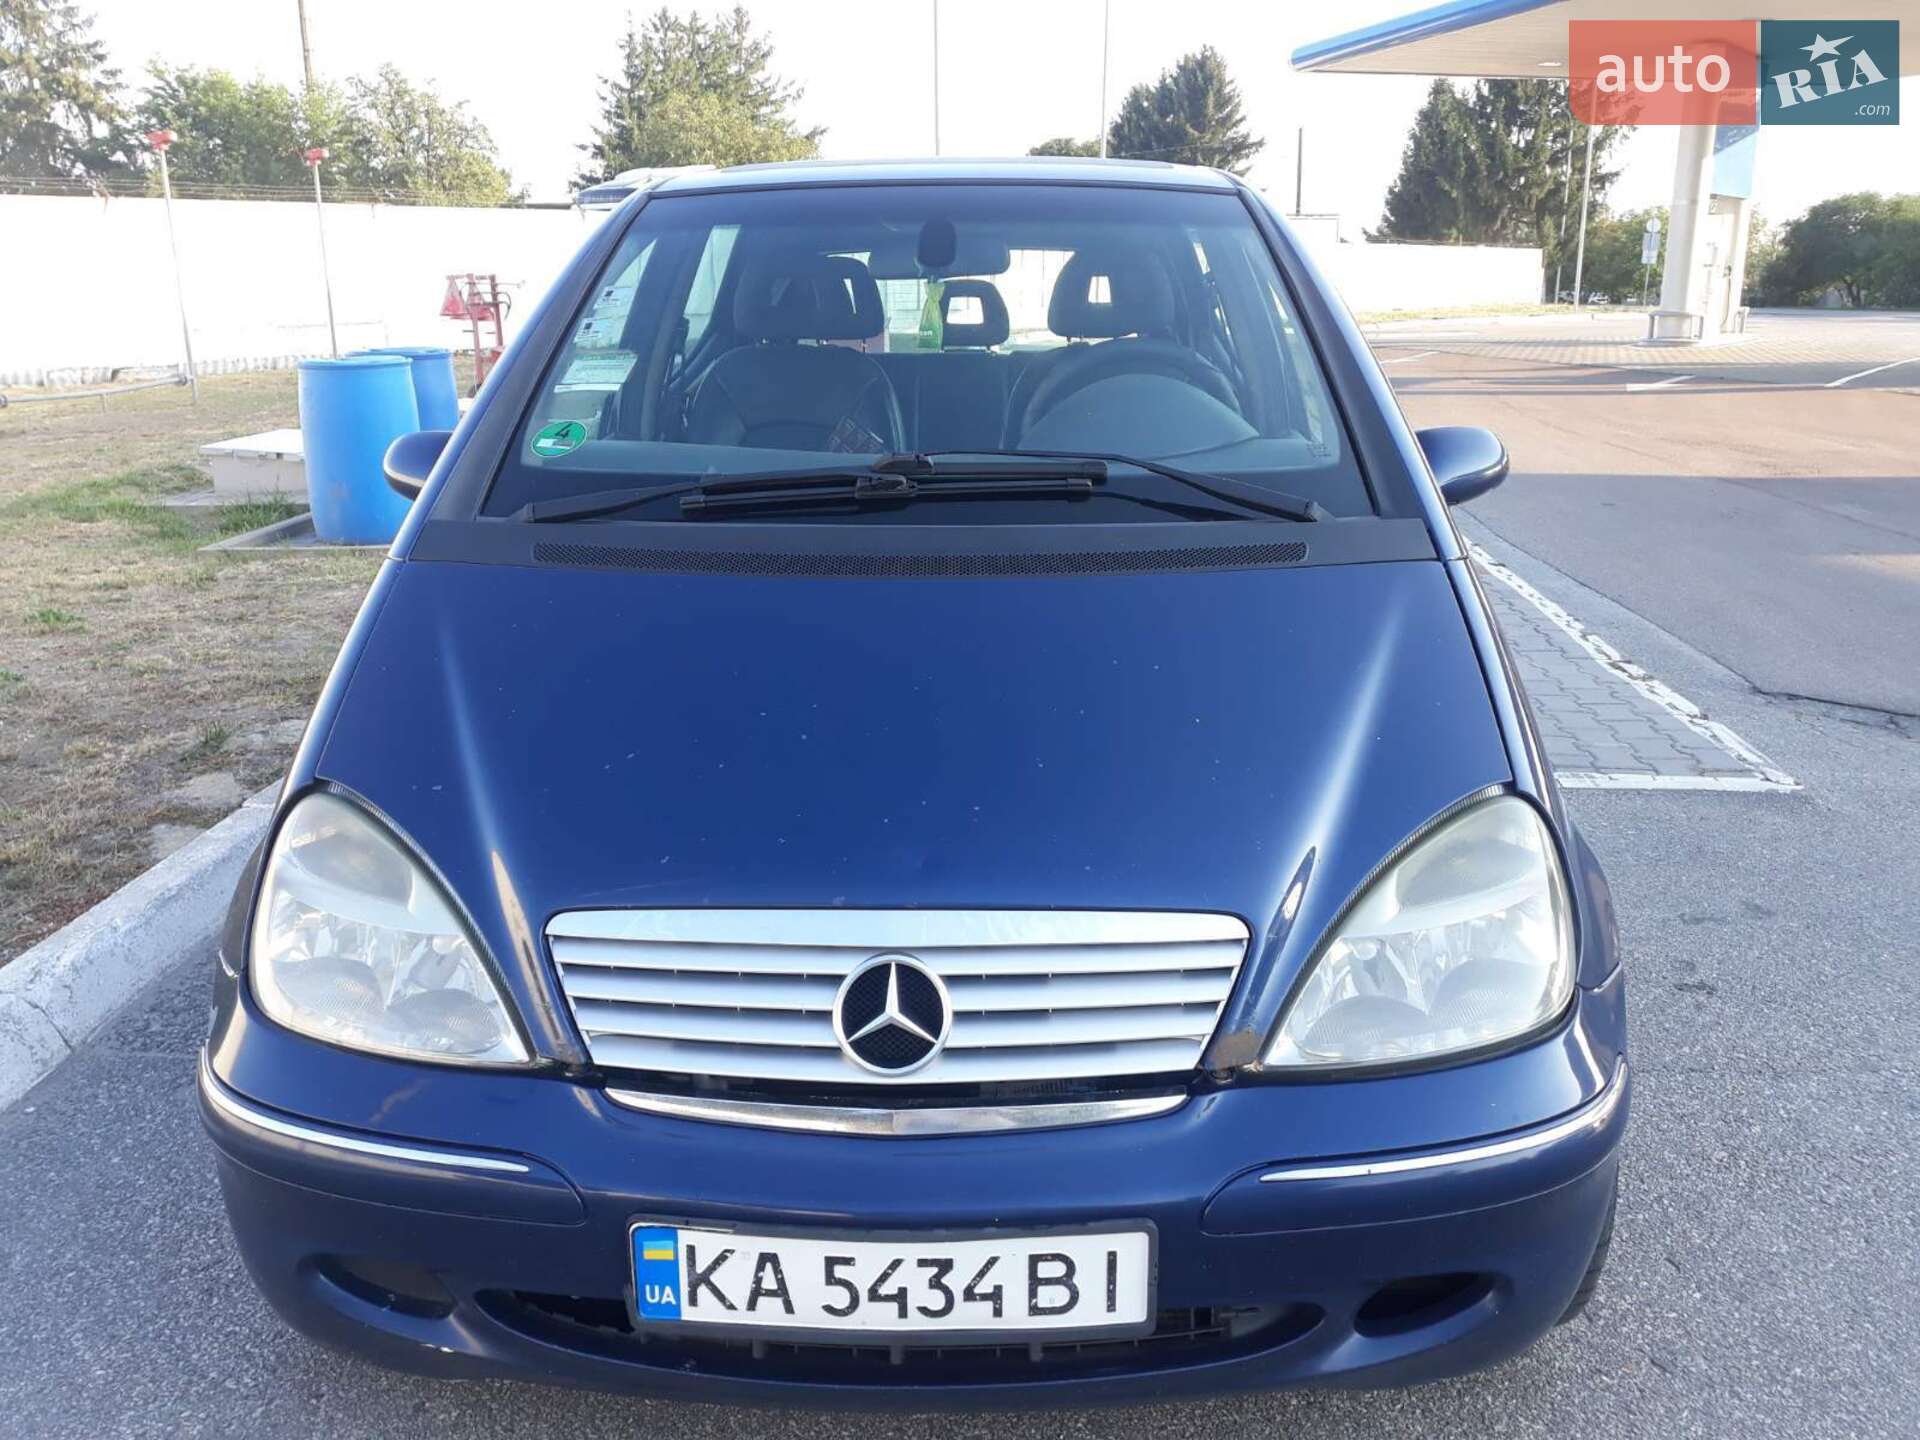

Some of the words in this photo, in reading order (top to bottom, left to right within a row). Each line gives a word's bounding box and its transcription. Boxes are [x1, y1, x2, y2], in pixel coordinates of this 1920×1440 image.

[555, 423, 573, 438] 4
[685, 1244, 796, 1315] KA
[820, 1254, 1003, 1319] 5434
[1027, 1250, 1118, 1317] BI
[645, 1284, 677, 1305] UA
